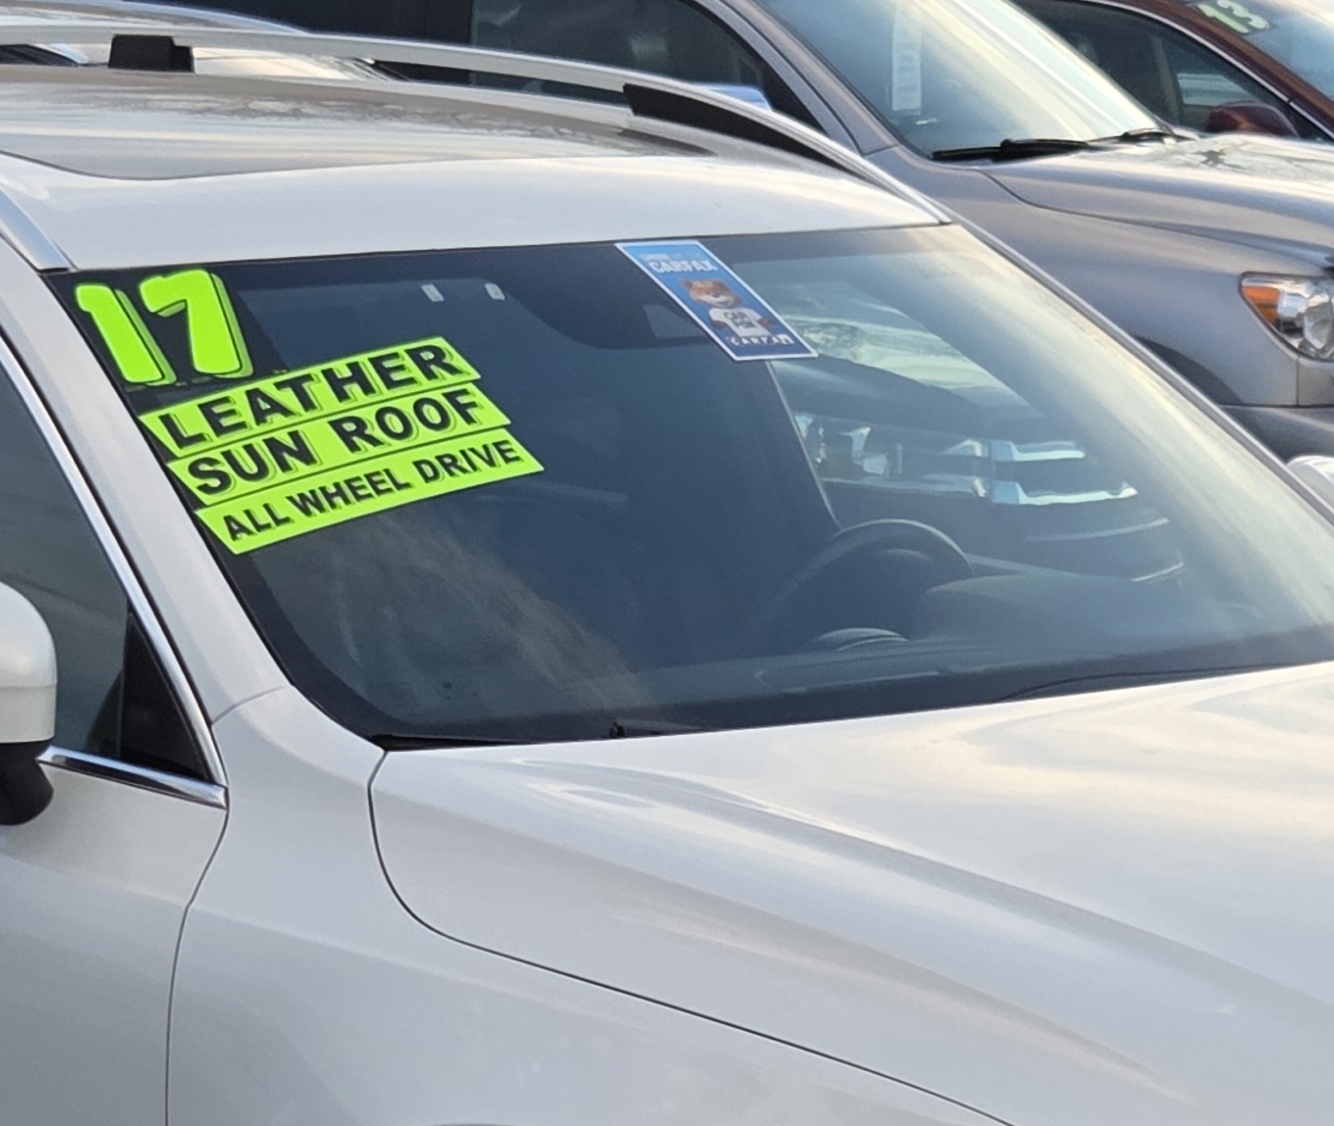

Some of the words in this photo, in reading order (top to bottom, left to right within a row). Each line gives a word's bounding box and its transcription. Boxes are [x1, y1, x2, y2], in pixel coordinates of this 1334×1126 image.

[648, 260, 718, 273] CARFAX
[74, 268, 252, 385] 17
[158, 343, 467, 450] LEATHER
[187, 430, 318, 496] SUN
[327, 389, 484, 454] ROOF
[222, 503, 292, 542] ALL
[285, 468, 412, 518] WHEEL
[414, 440, 524, 486] DRIVE
